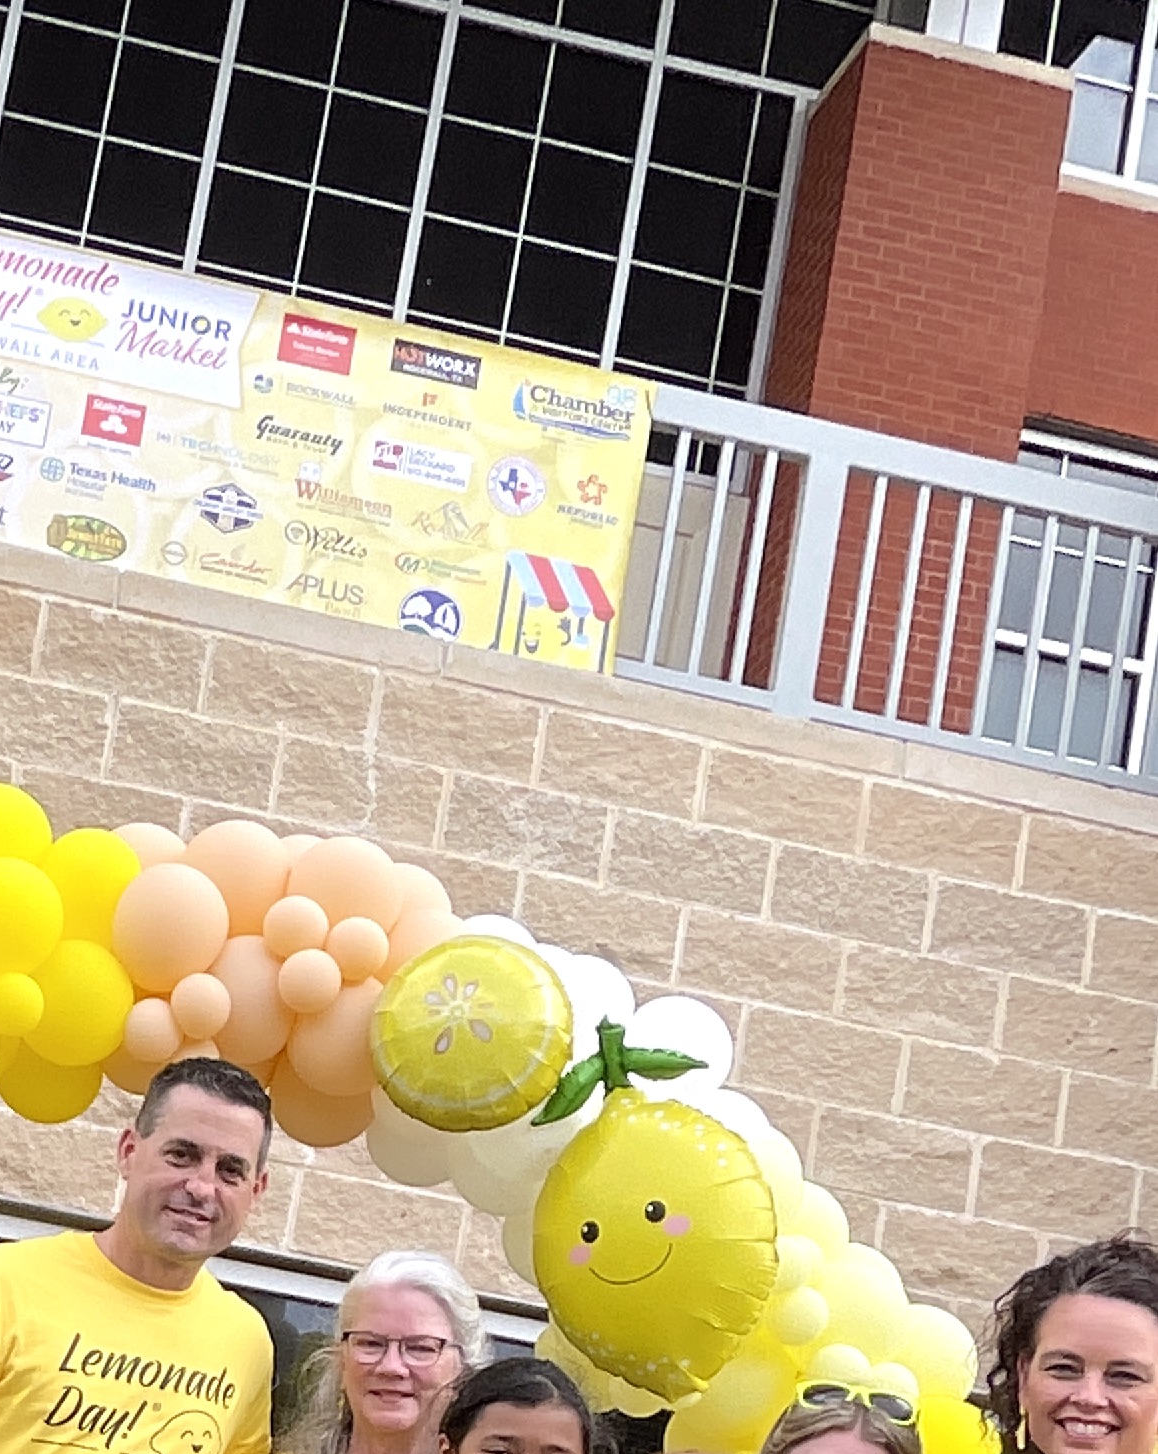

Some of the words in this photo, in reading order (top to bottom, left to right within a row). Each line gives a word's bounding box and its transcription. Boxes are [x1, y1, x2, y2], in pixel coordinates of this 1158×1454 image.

[121, 299, 232, 342] JUNIOR
[50, 349, 101, 372] AREA
[114, 320, 228, 371] Market
[394, 345, 476, 378] HOTWORX
[382, 402, 472, 431] INDEPENDENT
[529, 384, 636, 424] Chamber
[255, 414, 344, 456] Guaranty
[69, 462, 108, 482] Texas
[110, 470, 157, 493] Health
[58, 1332, 236, 1410] Lemonade
[43, 1385, 149, 1451] Day!
